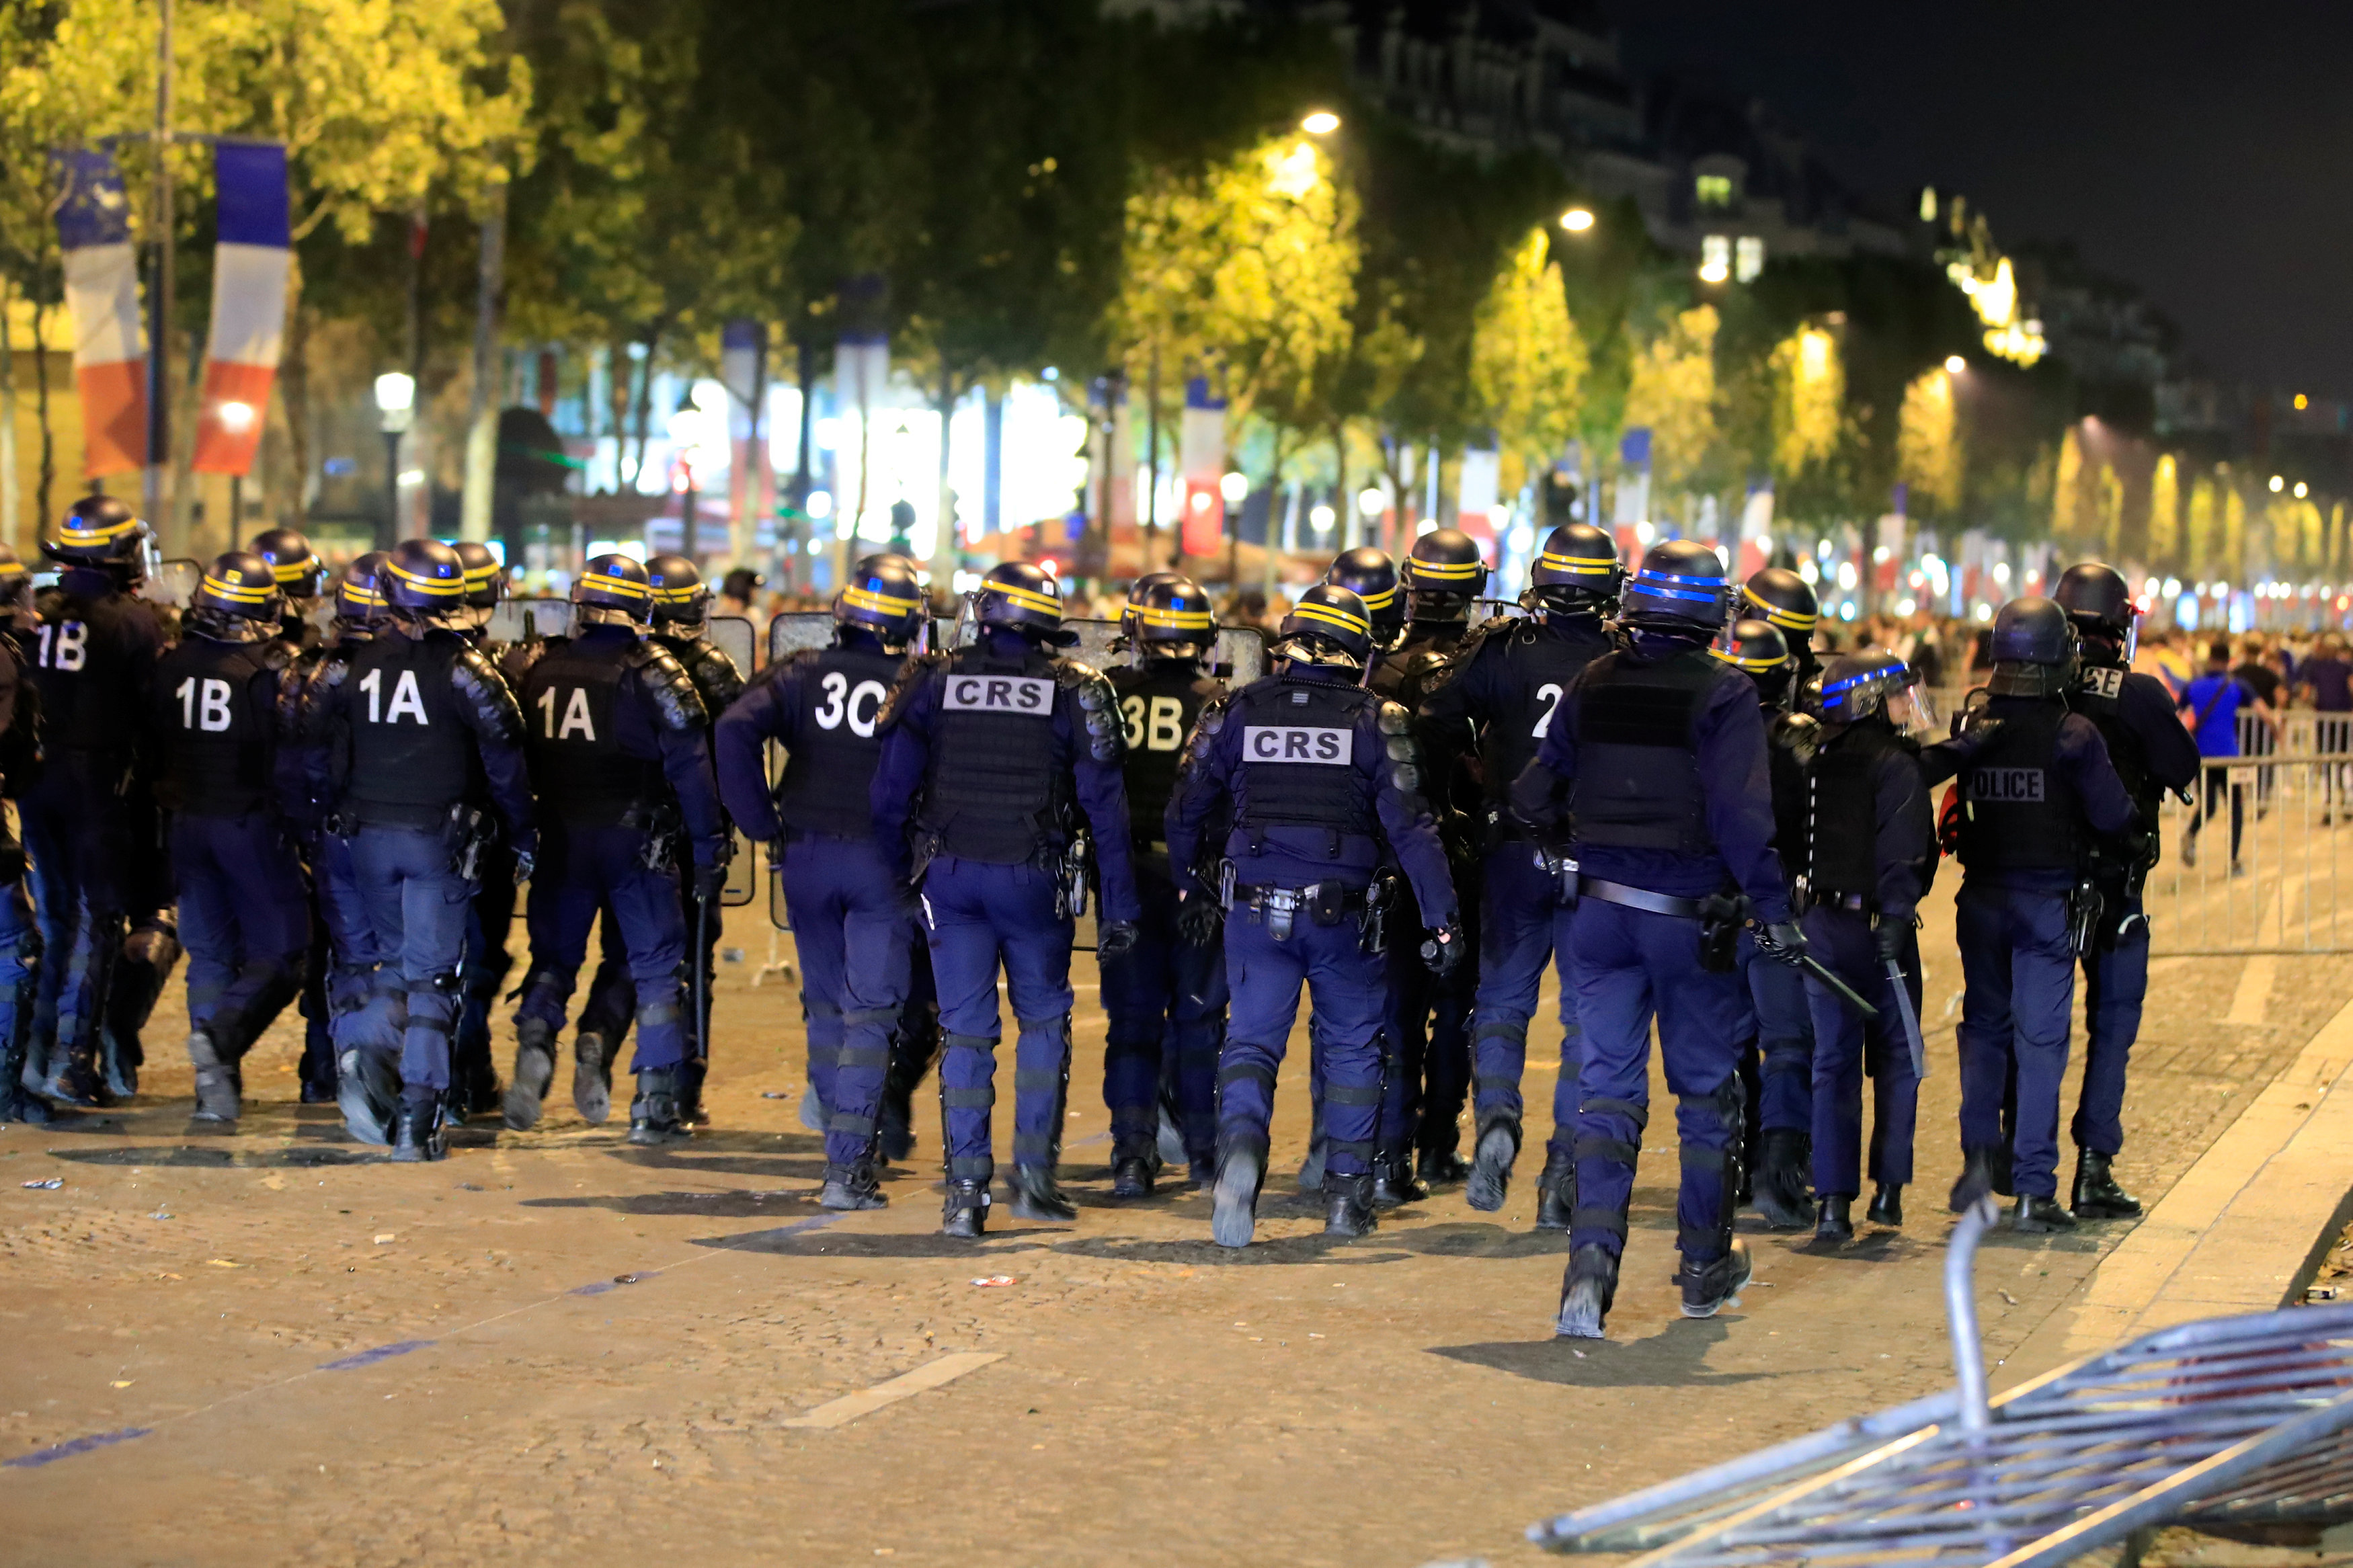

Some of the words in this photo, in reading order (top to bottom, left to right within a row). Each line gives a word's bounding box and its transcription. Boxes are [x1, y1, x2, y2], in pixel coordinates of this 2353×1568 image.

[38, 619, 88, 671] 1B
[176, 676, 231, 732] 1B
[360, 668, 428, 725] 1A
[538, 686, 596, 741] 1A
[955, 679, 1041, 708] CRS
[1531, 683, 1564, 738] 2
[1121, 694, 1183, 751] 3B
[1254, 730, 1340, 759] CRS
